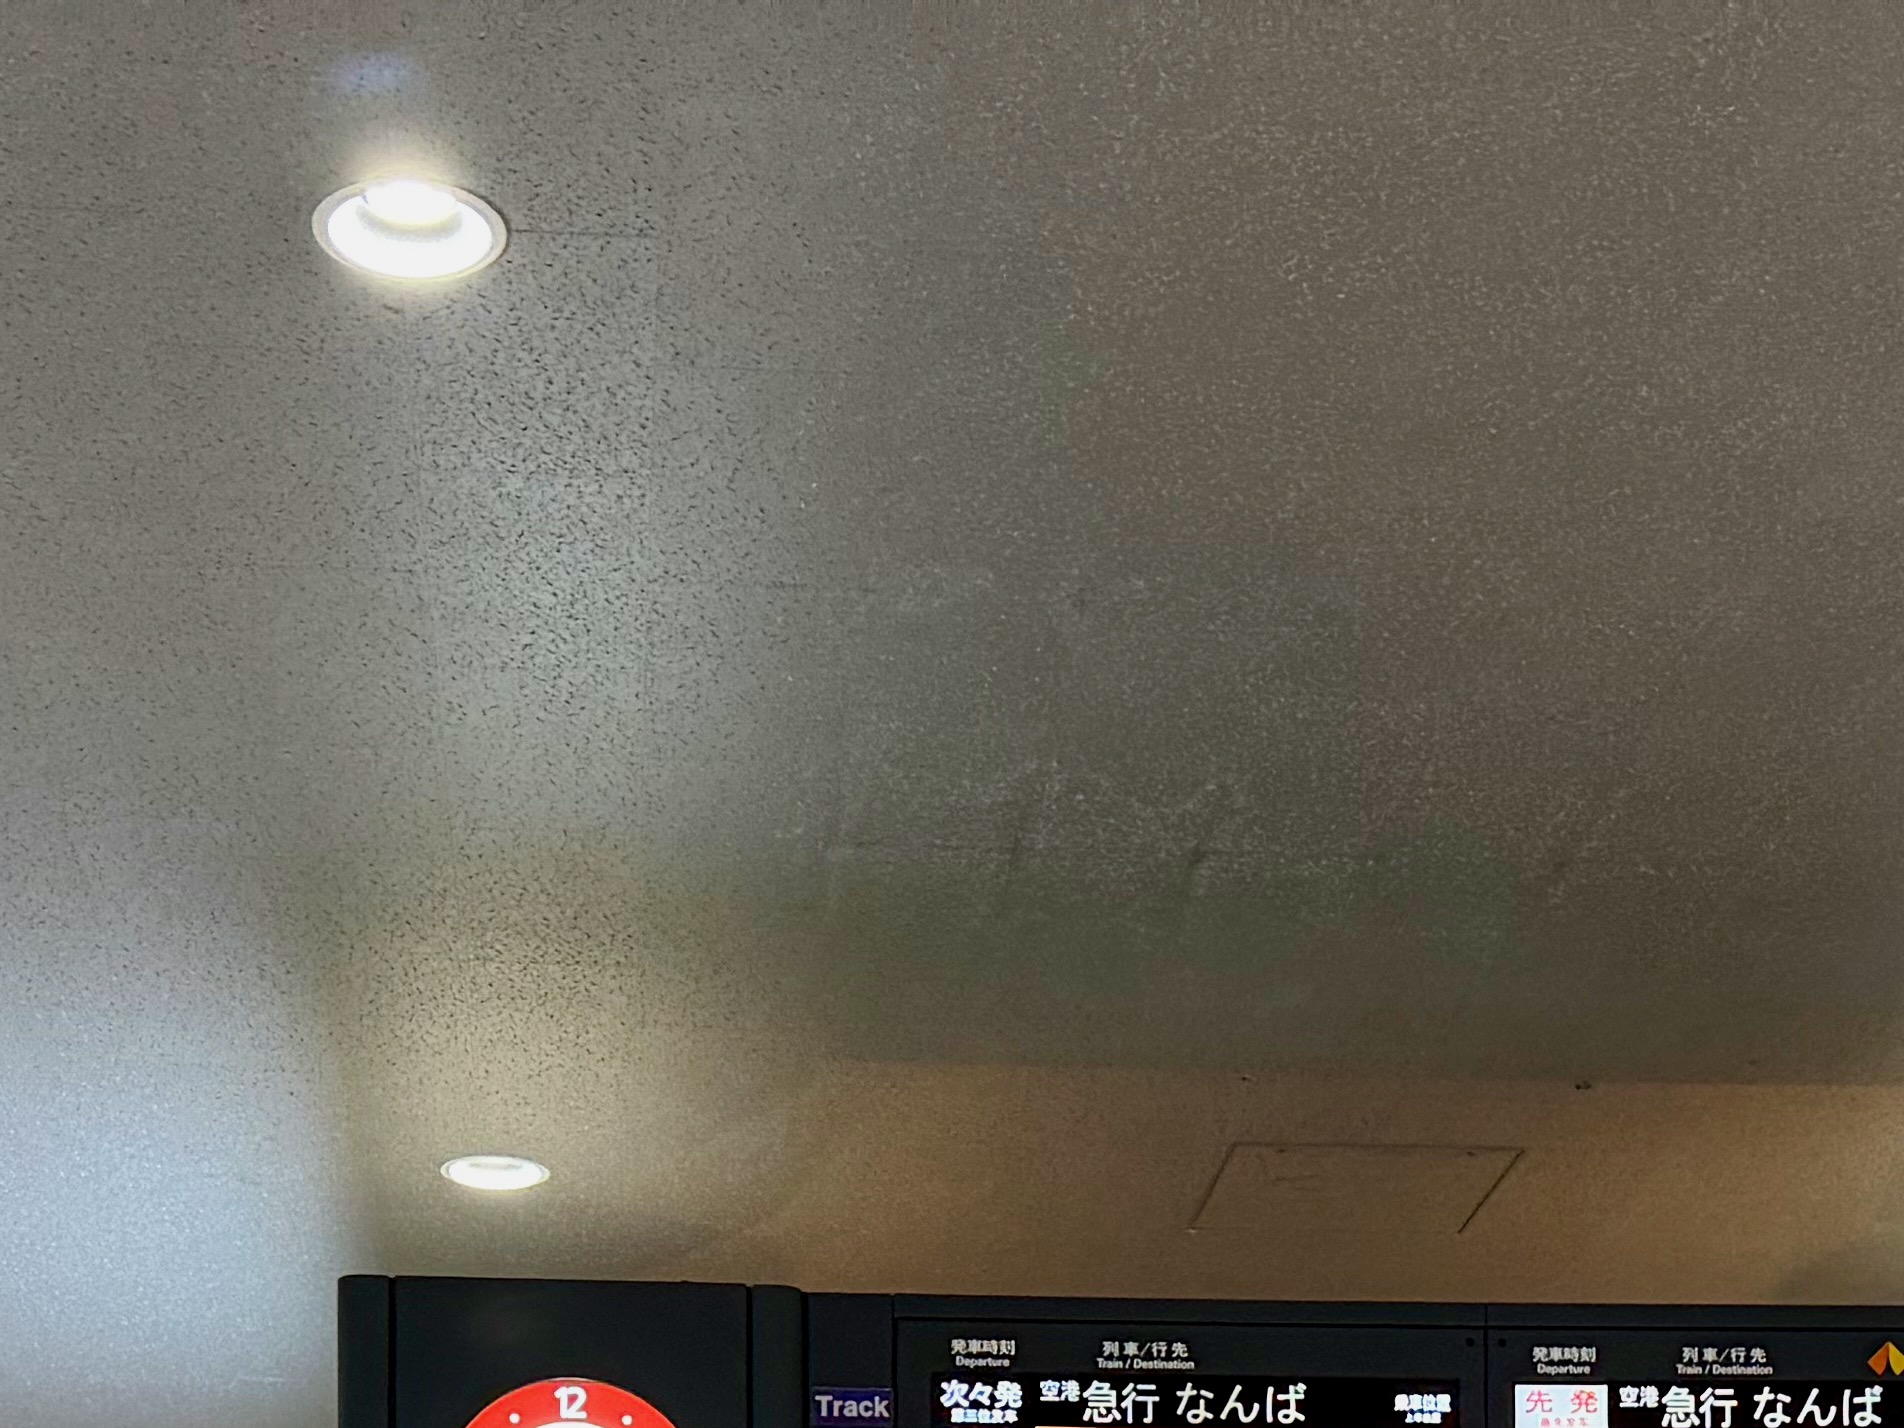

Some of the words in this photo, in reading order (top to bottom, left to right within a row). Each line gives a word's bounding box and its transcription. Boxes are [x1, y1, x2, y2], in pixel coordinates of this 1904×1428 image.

[951, 1339, 1016, 1355] 発車時刻
[1533, 1346, 1596, 1362] 発車時刻
[955, 1356, 1010, 1367] Departure
[1097, 1358, 1122, 1369] Train
[1134, 1358, 1194, 1369] Destination
[1537, 1364, 1590, 1376] Departure
[1676, 1364, 1702, 1375] Train
[1712, 1364, 1773, 1376] Destination
[939, 1379, 1023, 1408] 次々発
[553, 1386, 587, 1419] 12
[815, 1395, 890, 1418] Track
[1176, 1382, 1307, 1424] なんば
[1753, 1384, 1883, 1428] なんば
